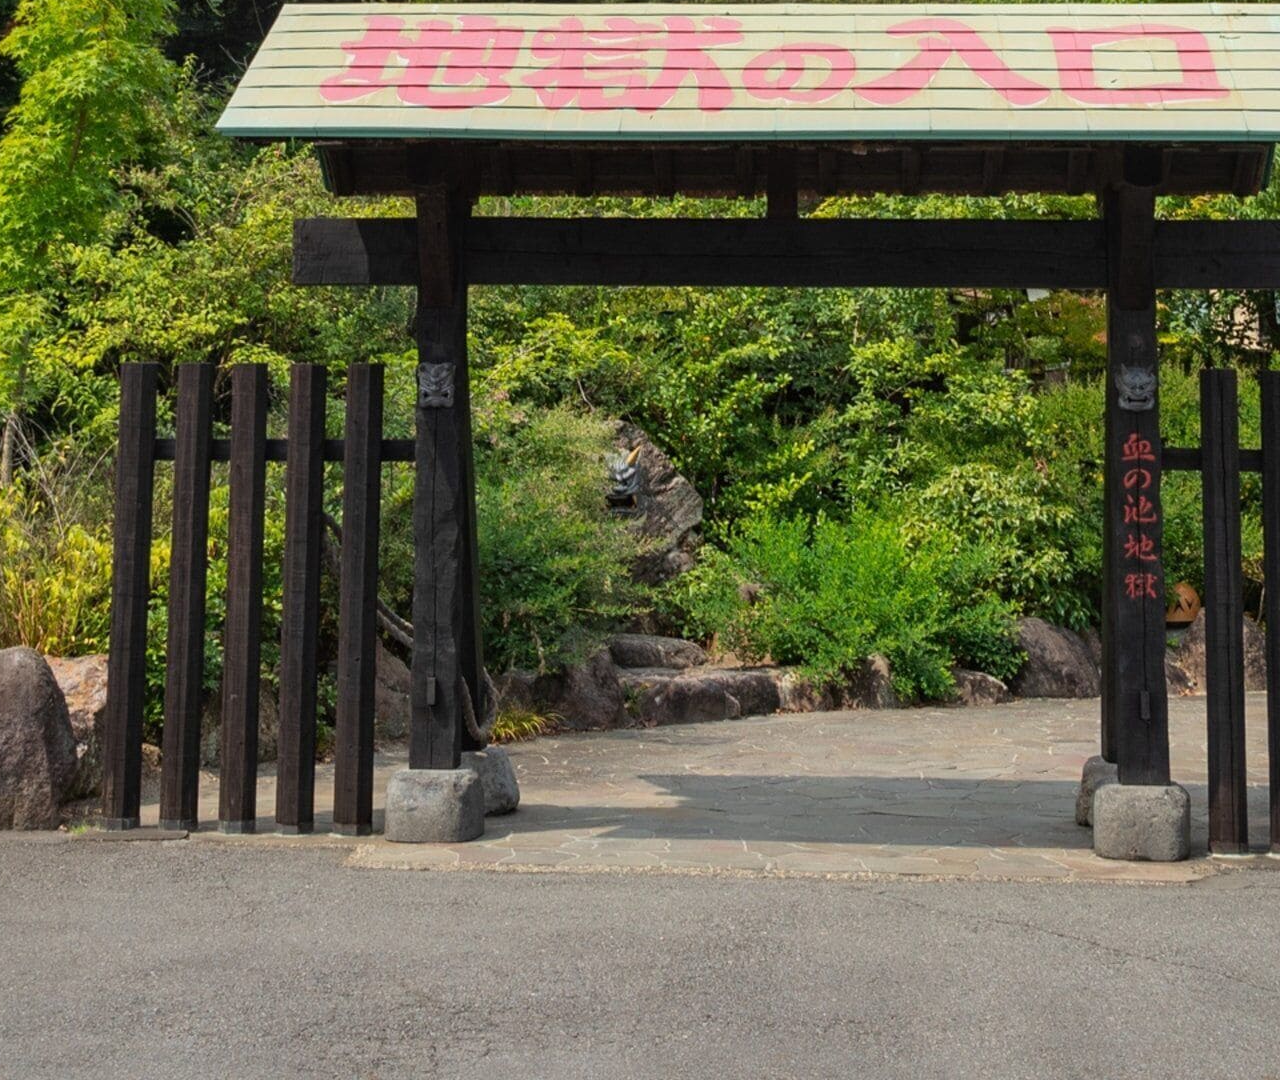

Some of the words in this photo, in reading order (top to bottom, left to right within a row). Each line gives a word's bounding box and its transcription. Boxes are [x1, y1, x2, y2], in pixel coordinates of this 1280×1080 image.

[318, 14, 1231, 113] 地獄の入口
[1121, 432, 1158, 599] 血の池地獄
